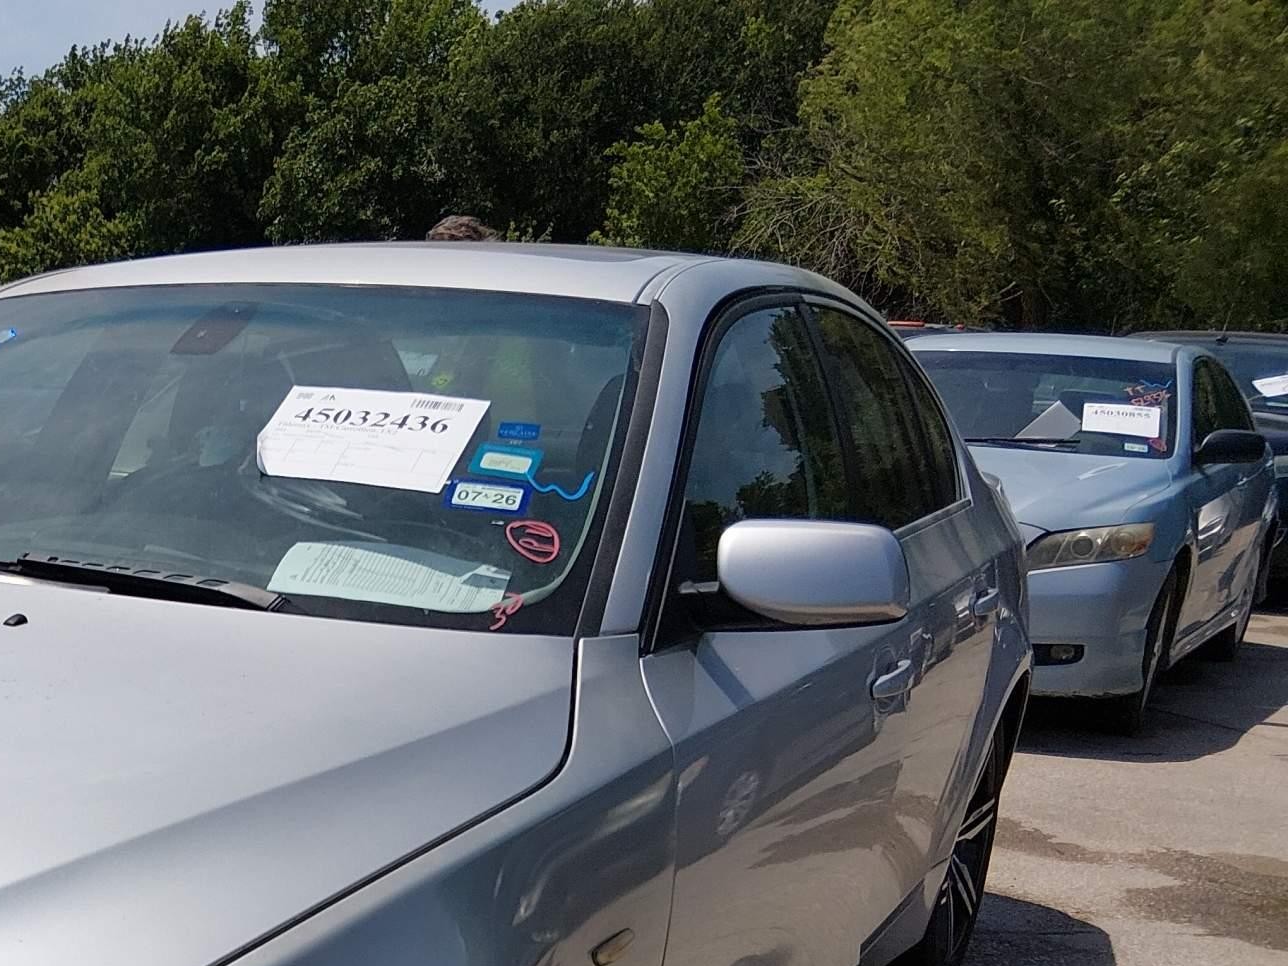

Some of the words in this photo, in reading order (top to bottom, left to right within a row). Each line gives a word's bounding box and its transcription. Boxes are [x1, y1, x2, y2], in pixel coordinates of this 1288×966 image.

[294, 407, 455, 434] 45032436
[457, 488, 481, 502] 07
[492, 492, 517, 506] 26
